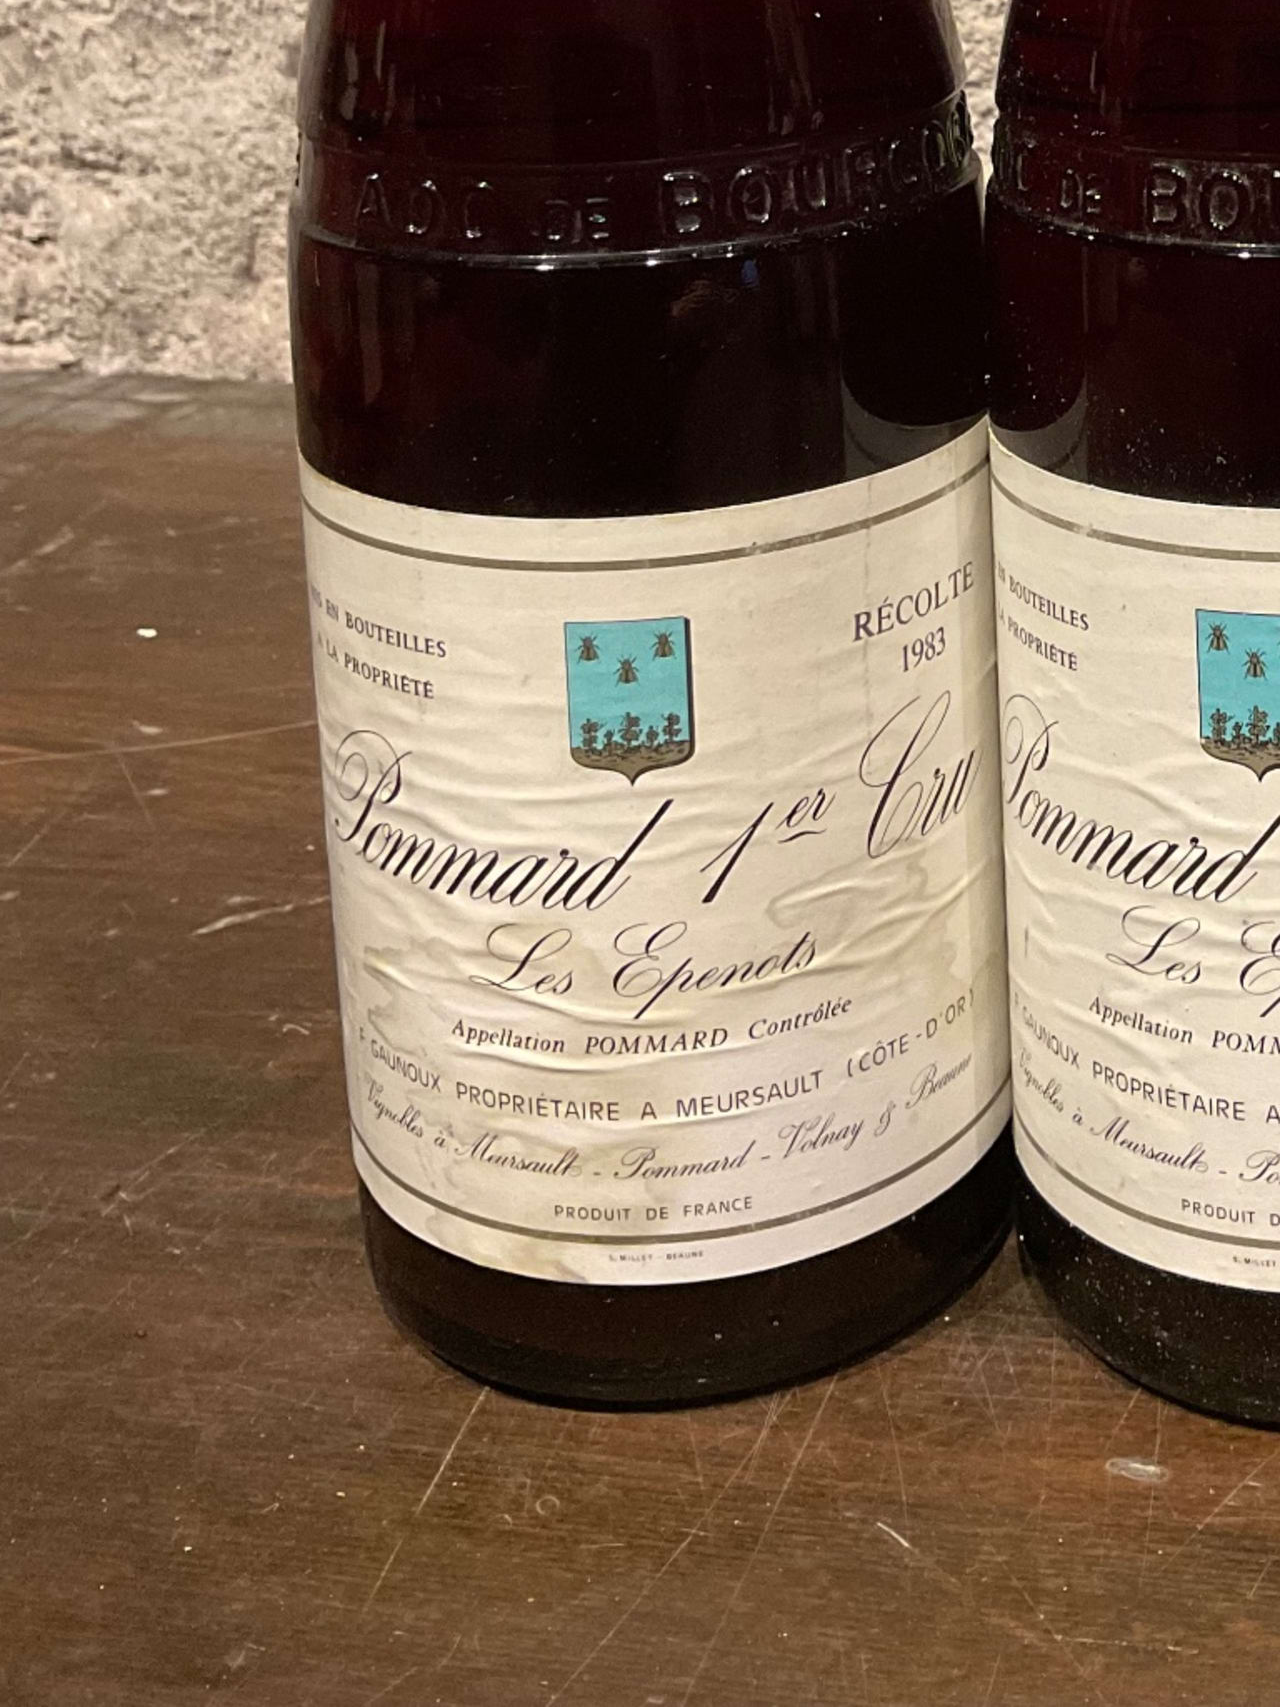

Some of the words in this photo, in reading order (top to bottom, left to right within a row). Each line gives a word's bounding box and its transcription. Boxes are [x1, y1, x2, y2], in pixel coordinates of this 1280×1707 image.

[852, 560, 976, 642] RÉCOLTE
[1008, 573, 1090, 631] BOUTEILLES
[345, 609, 447, 658] BOUTEILLES
[901, 625, 948, 673] 1983
[1007, 615, 1079, 672] PROPRIÉTÉ
[344, 652, 434, 700] PROPRIÉTÉ
[334, 729, 674, 911] Pommard
[859, 689, 983, 859] Cru
[468, 922, 574, 996] Les
[612, 921, 817, 1020] Epenots
[1105, 904, 1201, 985] Les
[451, 1018, 566, 1054] Appellation
[584, 1027, 729, 1055] POMMARD
[748, 997, 852, 1040] Contrôlée
[1088, 995, 1194, 1045] Appellation
[371, 1038, 441, 1092] GAUNOUX
[456, 1081, 620, 1121] PROPRIÉTAIRE
[640, 1102, 657, 1120] A
[676, 1069, 823, 1118] MEURSAULT
[1092, 1059, 1246, 1122] PROPRIÉTAIRE
[455, 1132, 582, 1178] Meursault
[613, 1140, 756, 1180] Pommard
[778, 1112, 865, 1159] Volnay
[904, 1053, 973, 1109] Beaune
[1089, 1115, 1210, 1174] Meursault
[554, 1204, 632, 1222] PRODUIT
[645, 1206, 670, 1221] DE
[683, 1196, 754, 1217] FRANCE
[1181, 1198, 1256, 1225] PRODUIT
